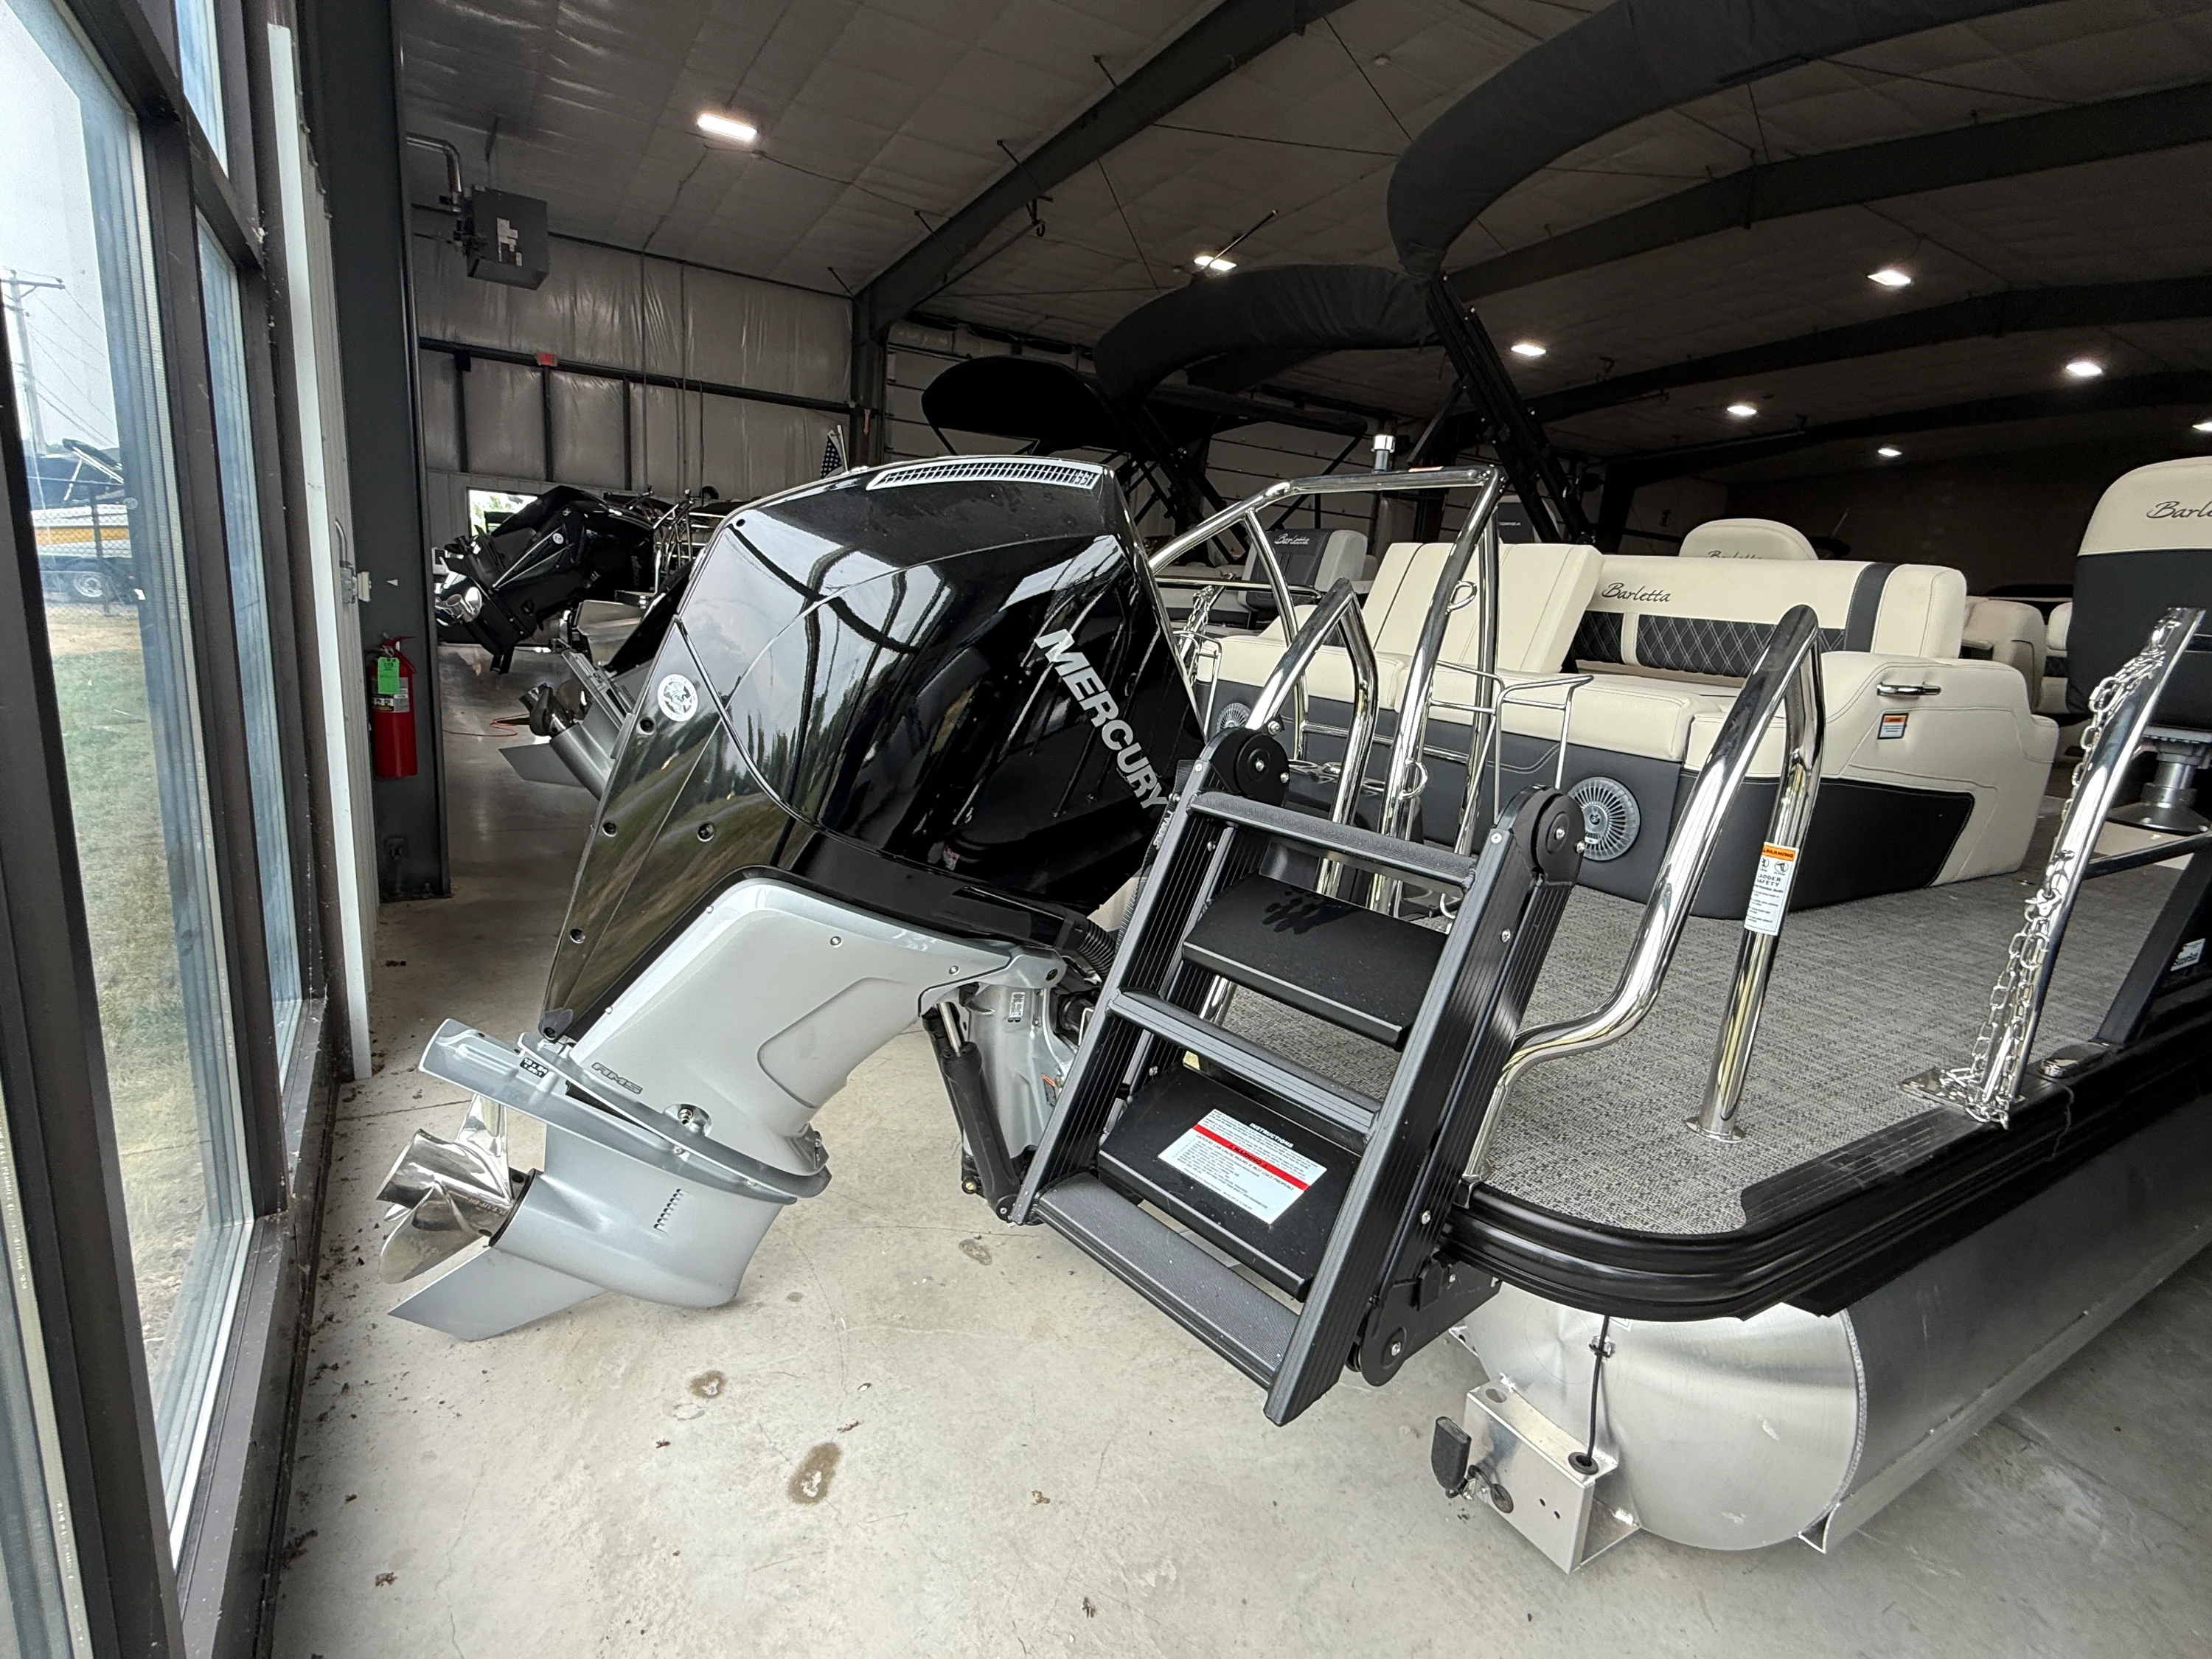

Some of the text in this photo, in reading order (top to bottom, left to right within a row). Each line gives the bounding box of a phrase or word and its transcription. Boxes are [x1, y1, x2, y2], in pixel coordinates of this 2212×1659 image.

[1601, 582, 1671, 602] Barletta
[1034, 629, 1169, 809] MERCURY
[592, 1062, 643, 1094] AMS
[1249, 1123, 1294, 1148] INSTRUCTIONS
[1234, 1147, 1262, 1164] WARNING
